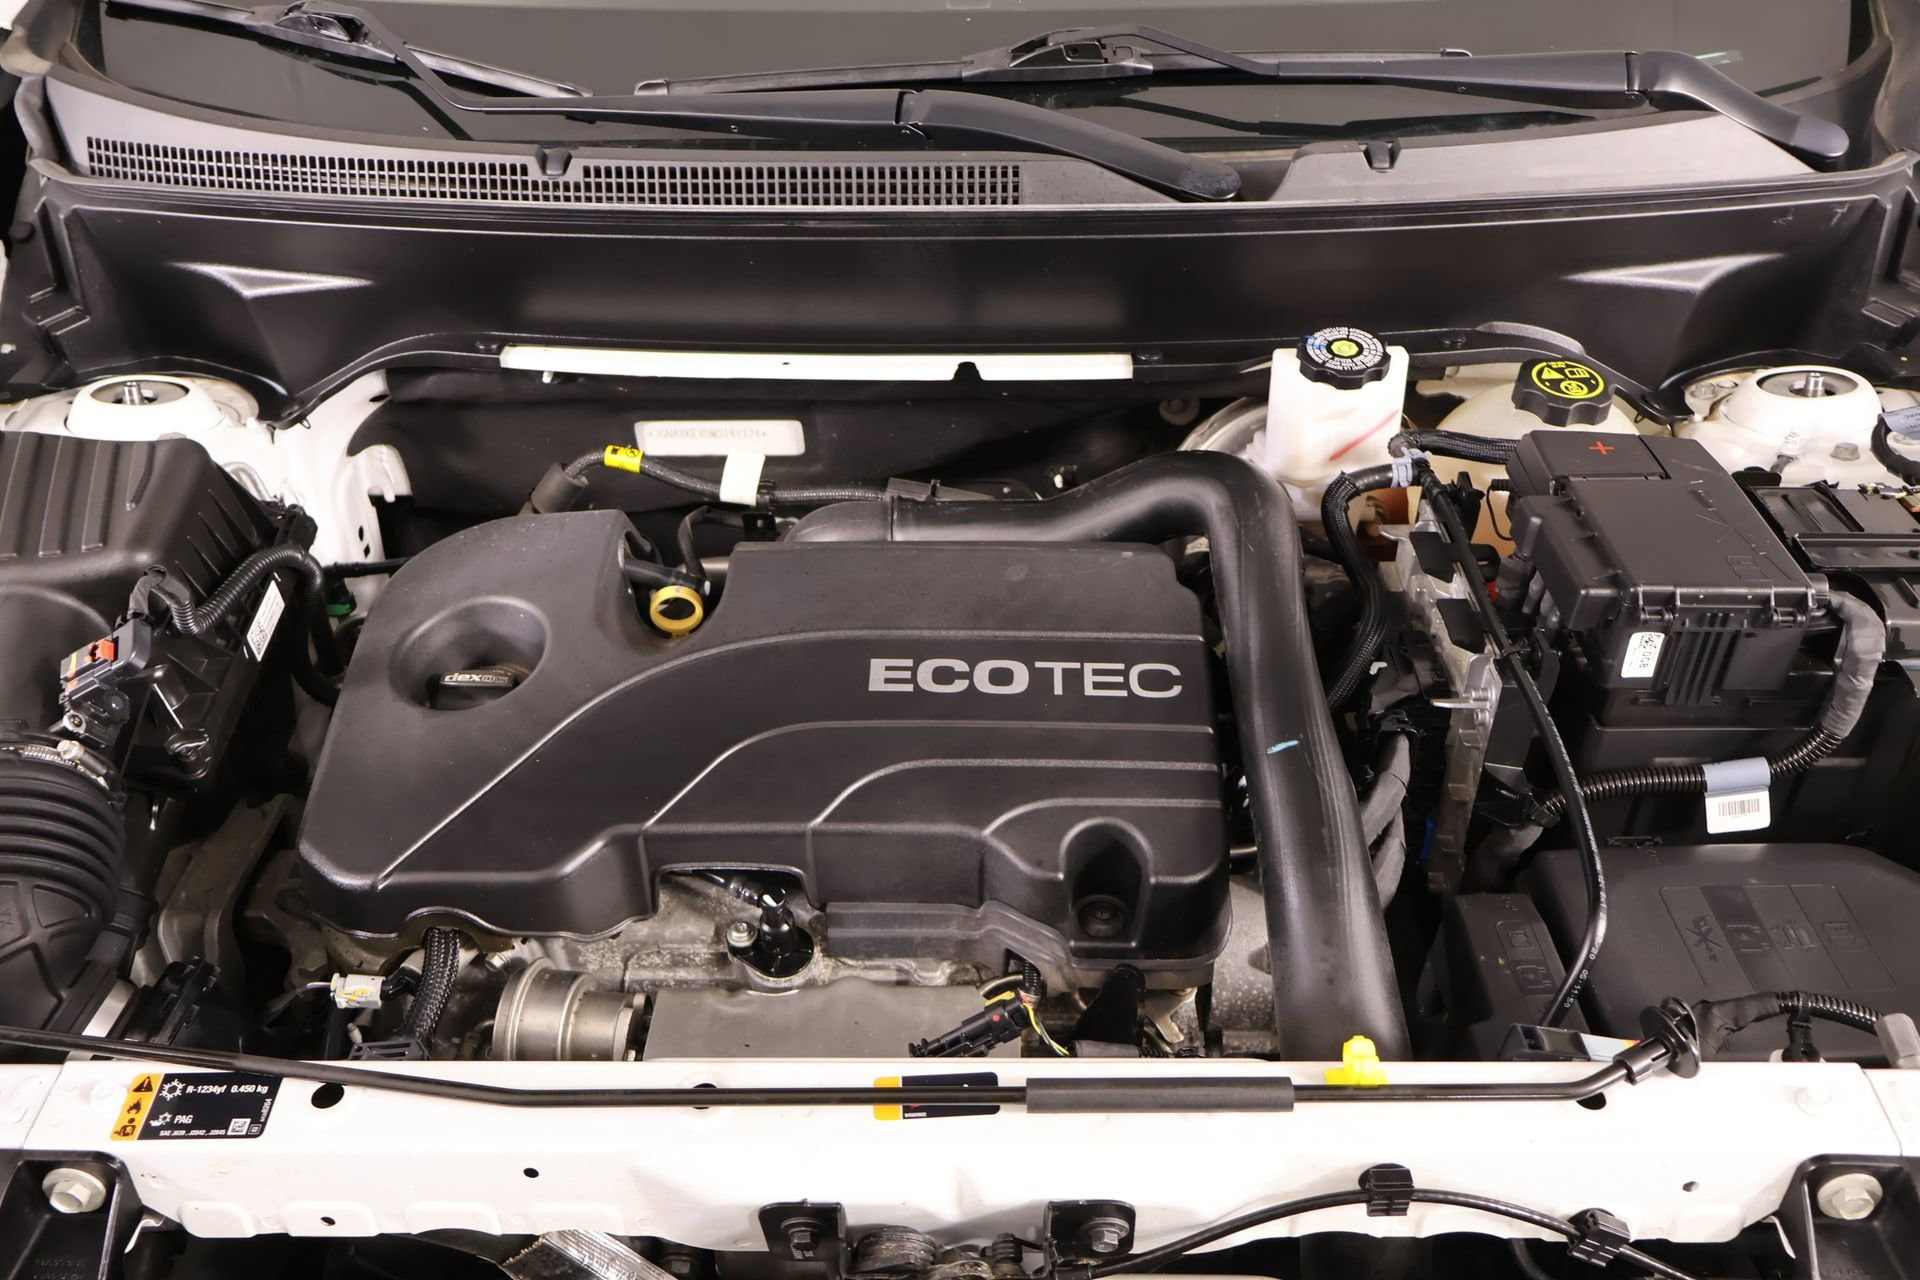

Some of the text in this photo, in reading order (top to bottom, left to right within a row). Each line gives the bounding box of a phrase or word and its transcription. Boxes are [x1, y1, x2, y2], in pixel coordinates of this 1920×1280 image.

[868, 658, 1183, 698] ECOTEC
[186, 1085, 269, 1094] R-1234yf 0.450 kg
[174, 1114, 194, 1124] PAG
